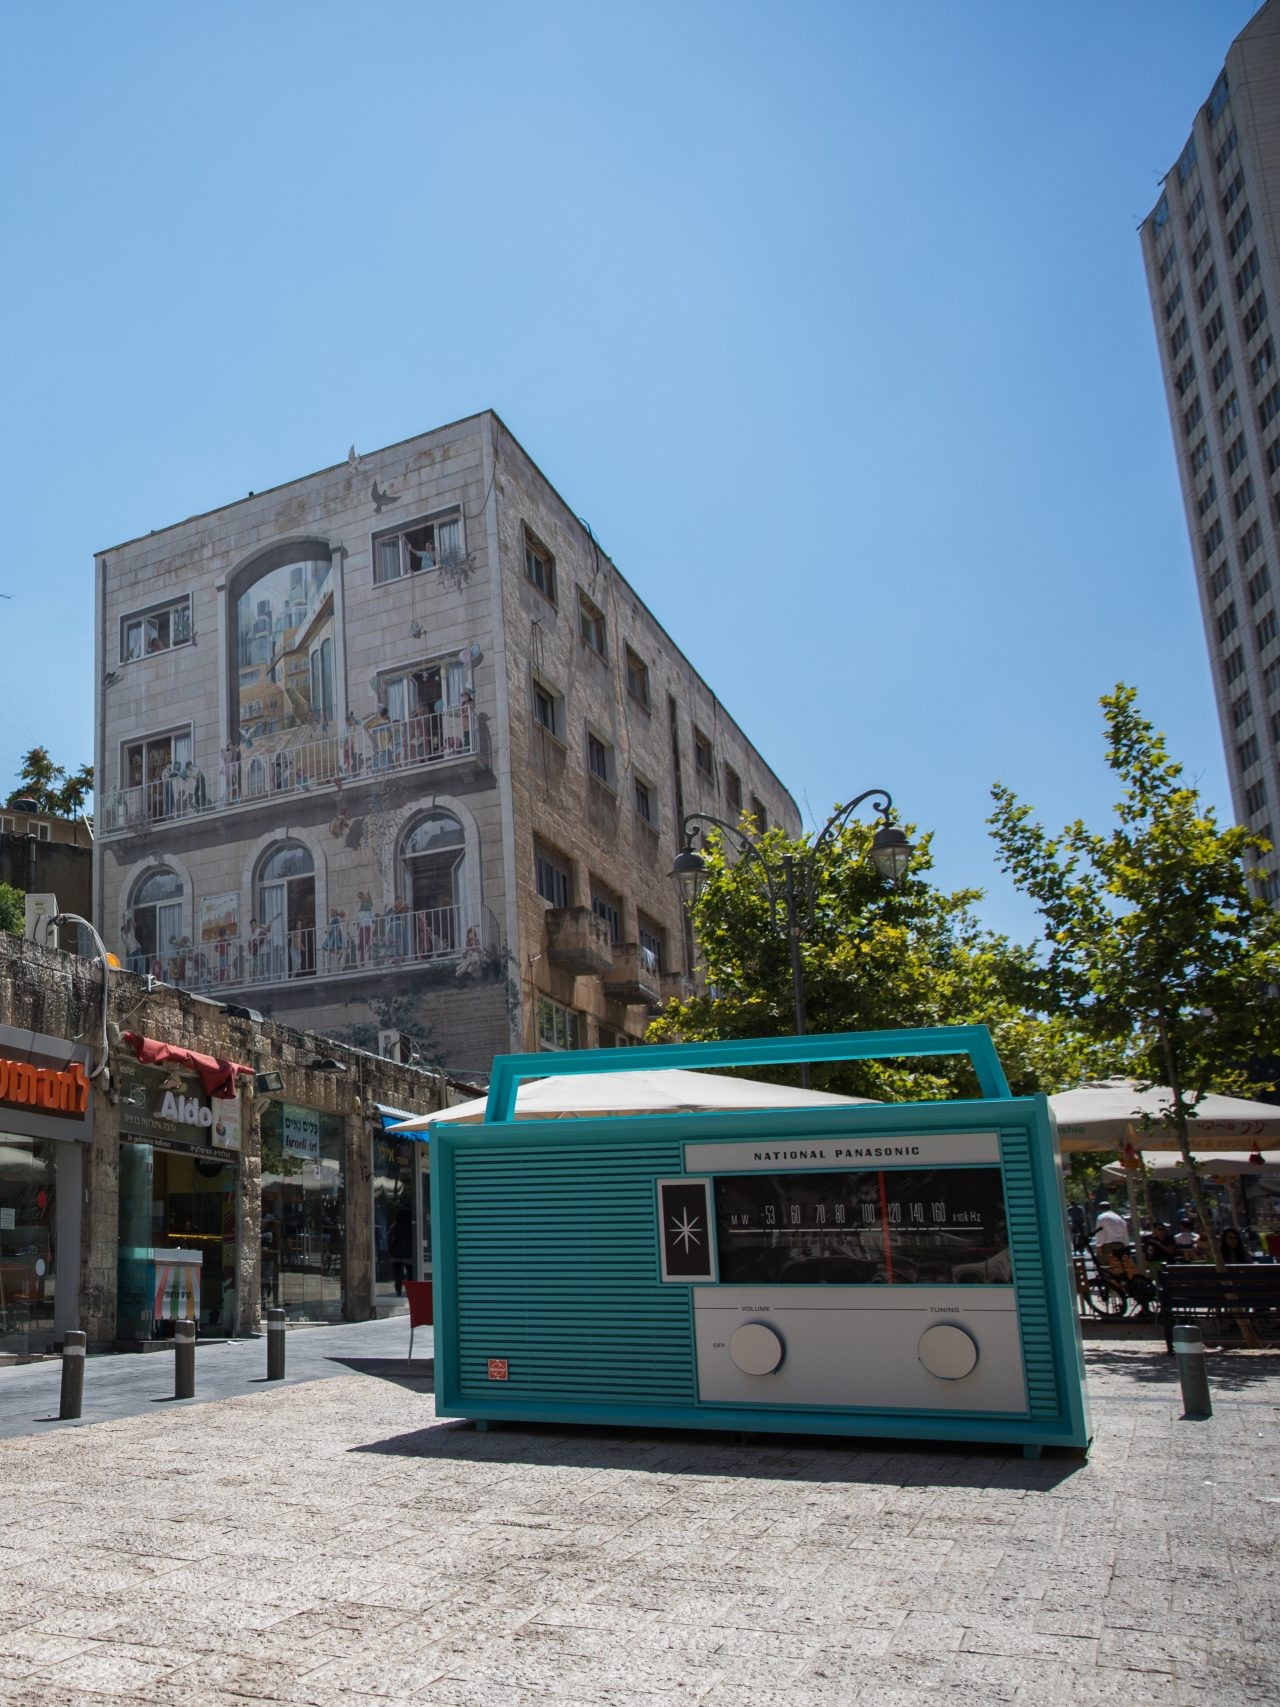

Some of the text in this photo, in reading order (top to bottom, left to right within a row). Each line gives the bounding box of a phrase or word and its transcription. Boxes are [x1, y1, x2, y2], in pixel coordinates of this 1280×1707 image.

[161, 1091, 212, 1127] Aldo
[753, 1146, 920, 1161] NATIONAL PANASONIC
[765, 1205, 775, 1224] 53
[790, 1205, 801, 1224] 60
[816, 1204, 826, 1224] 70
[835, 1204, 845, 1223] 80
[861, 1203, 875, 1223] 100
[887, 1203, 902, 1223] 120
[909, 1202, 924, 1222] 140
[931, 1202, 946, 1222] 160
